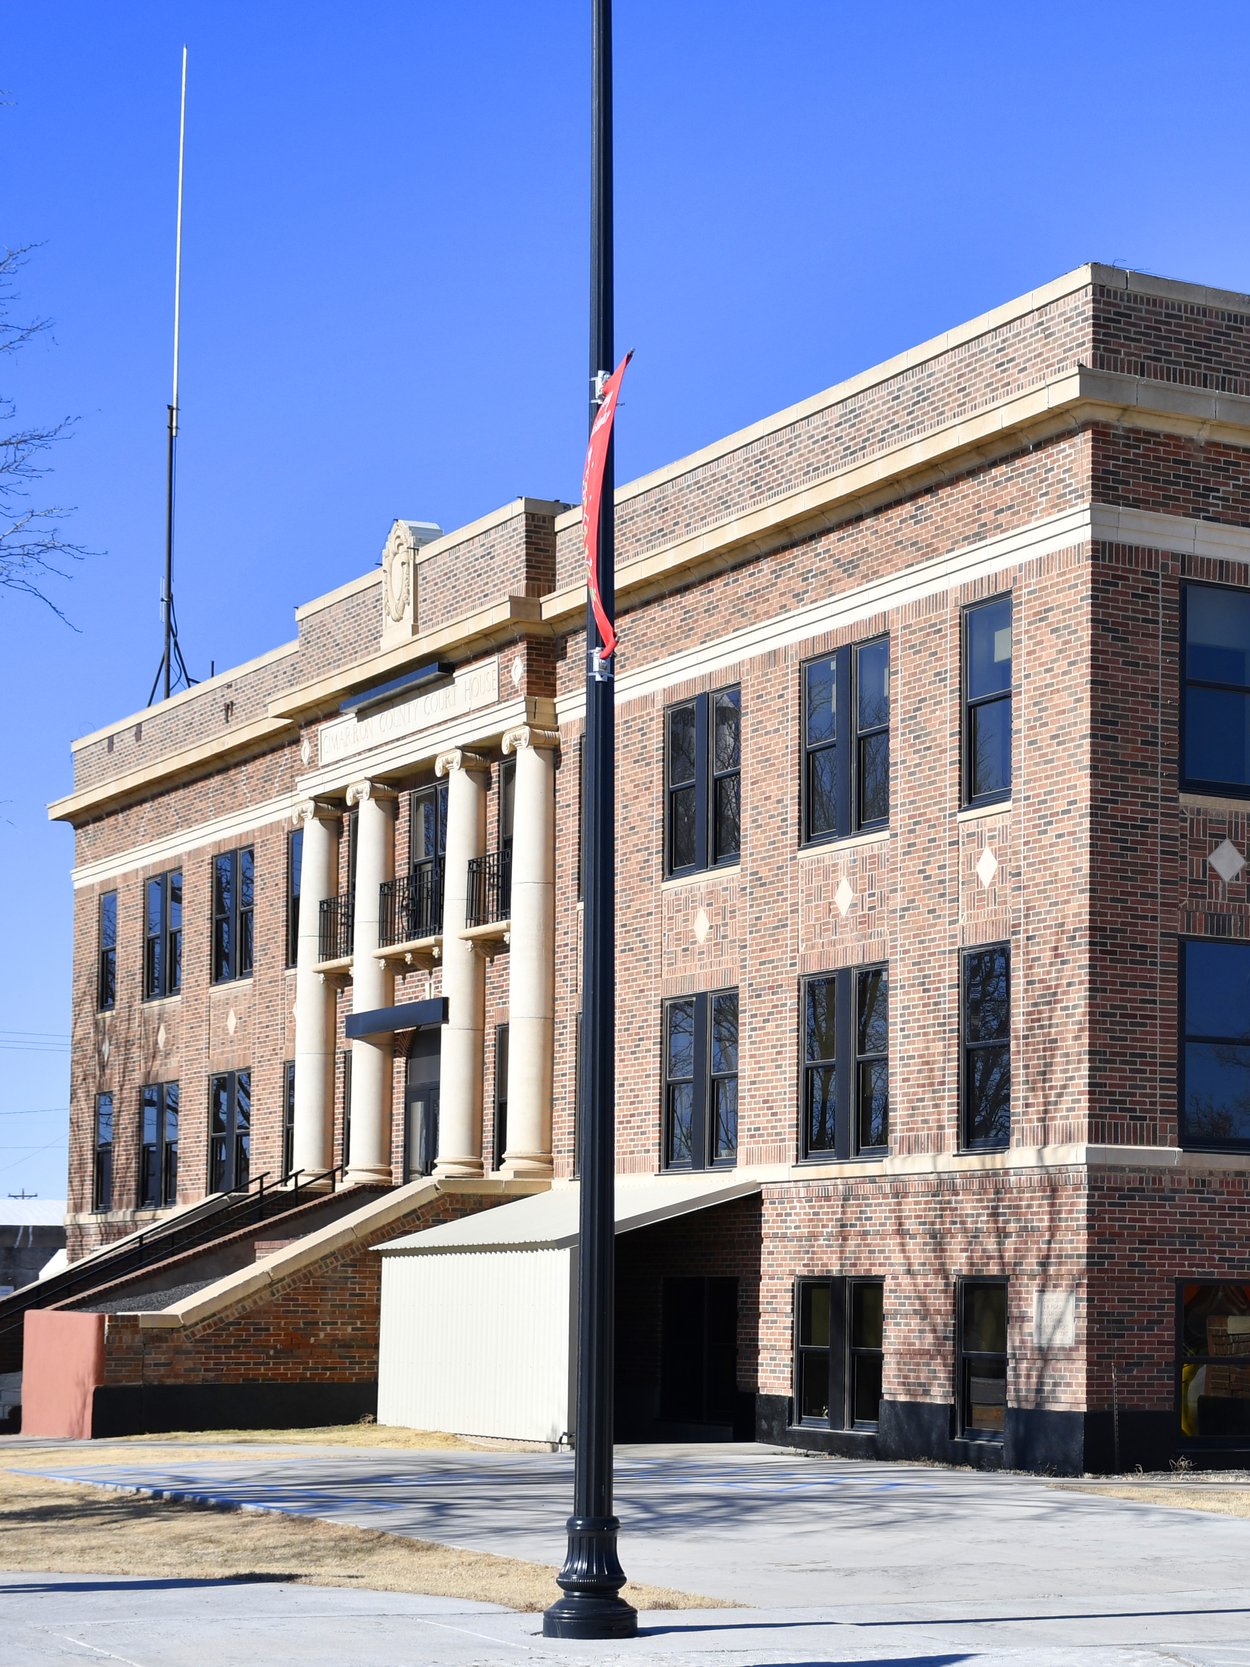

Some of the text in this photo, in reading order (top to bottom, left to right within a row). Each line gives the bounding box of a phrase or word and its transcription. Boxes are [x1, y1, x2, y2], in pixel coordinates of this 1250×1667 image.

[379, 700, 419, 733] COUNTY
[424, 684, 458, 716] COURT
[464, 669, 497, 703] HOUSE
